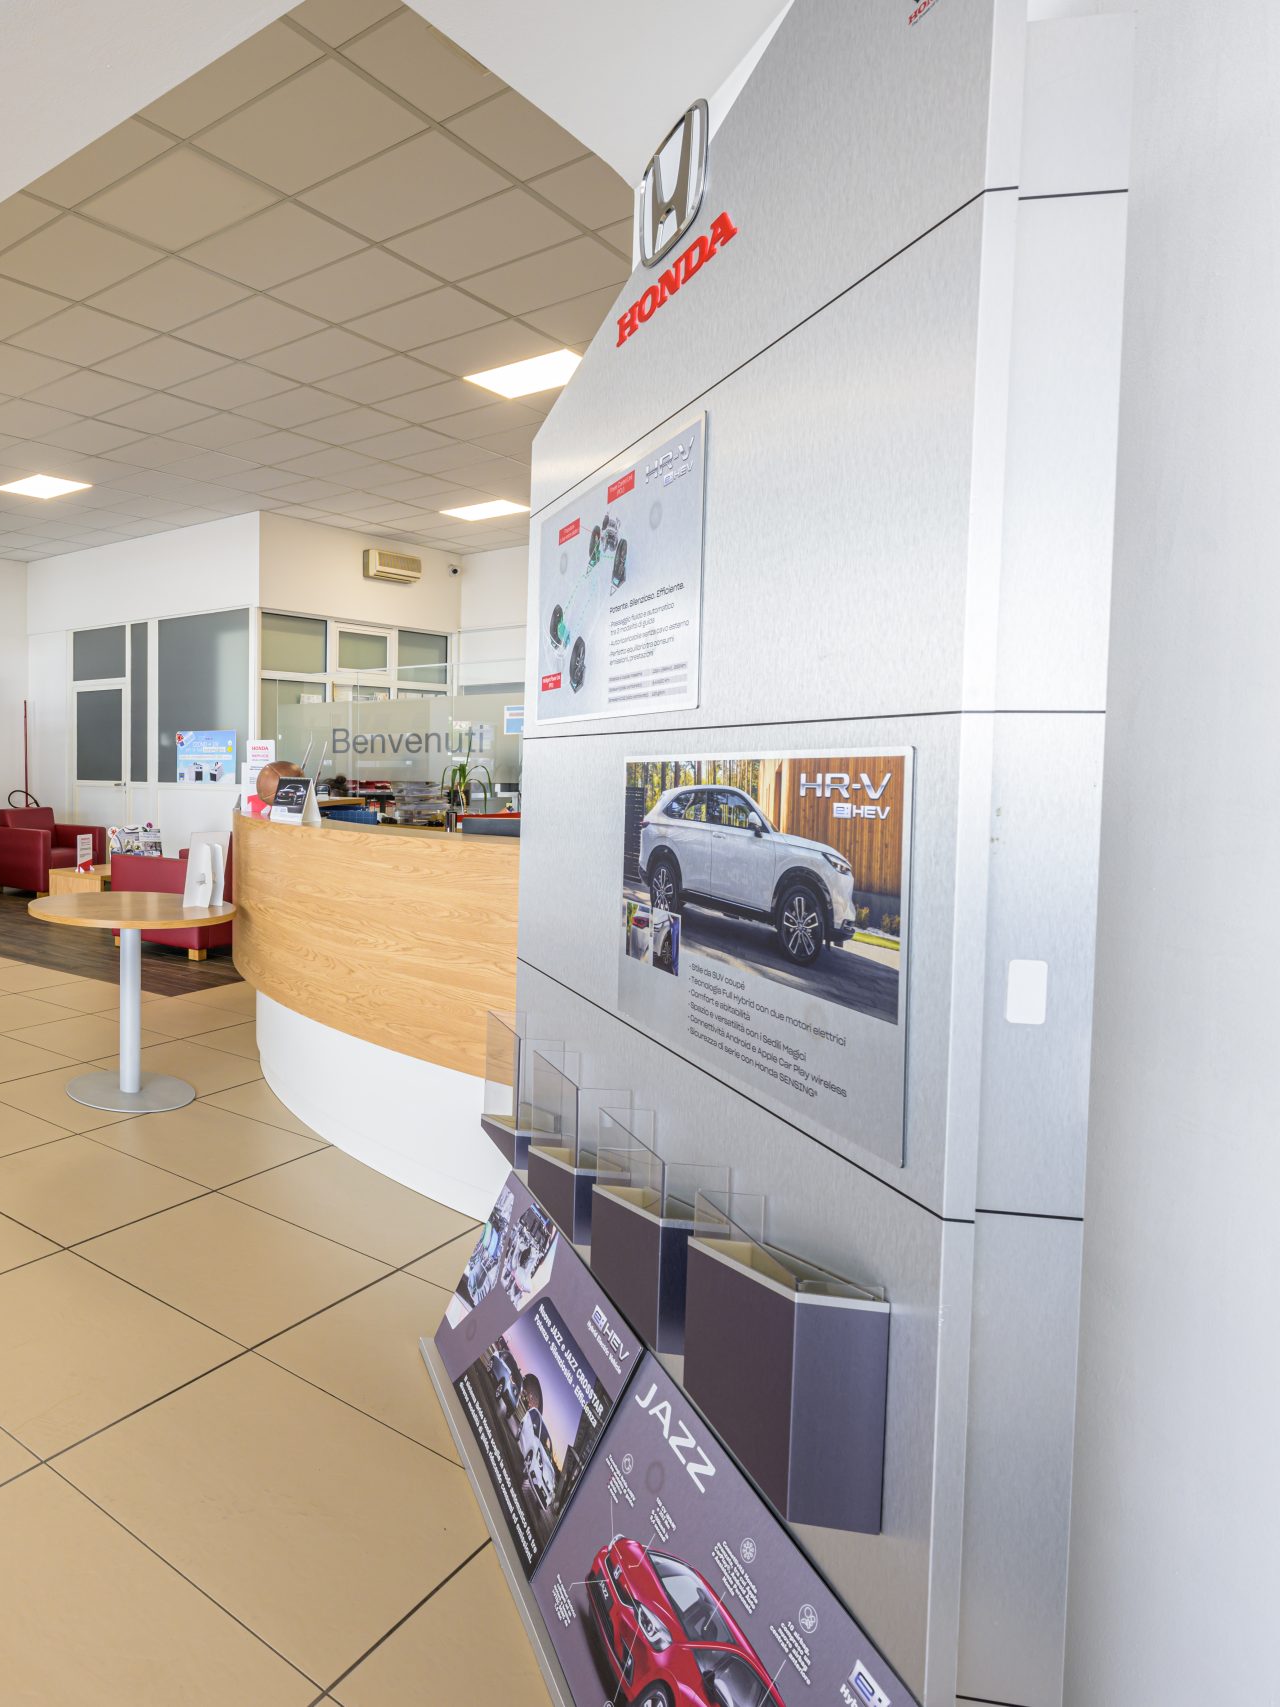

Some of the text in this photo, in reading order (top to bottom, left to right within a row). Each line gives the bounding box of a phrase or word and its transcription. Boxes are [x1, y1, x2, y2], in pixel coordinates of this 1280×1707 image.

[616, 211, 738, 348] HONDA
[645, 435, 695, 484] HR-V
[656, 582, 685, 598] Efficiente.
[332, 725, 484, 754] Benvenuti
[800, 773, 891, 799] HR-V
[690, 988, 714, 1005] Comfort
[720, 1001, 751, 1021] abitabilità
[703, 968, 711, 977] da
[712, 971, 724, 982] SUV
[724, 977, 746, 990] coupé
[690, 1001, 709, 1016] Spazio
[714, 1013, 745, 1032] versatilità
[745, 1028, 759, 1040] con
[762, 1034, 781, 1050] Sedili
[782, 1043, 807, 1062] Magici
[691, 976, 847, 1046] Tecnologia Full Hybrid con due motori elettrici
[689, 1026, 718, 1047] Sicurezza
[724, 1045, 740, 1059] serie
[740, 1054, 755, 1067] con
[754, 1062, 778, 1079] Honda
[690, 1014, 725, 1037] Connettività
[725, 1031, 751, 1050] Android
[757, 1047, 778, 1064] Apple
[779, 1057, 792, 1070] Car
[793, 1064, 810, 1080] Play
[810, 1074, 847, 1097] wireless
[534, 1314, 549, 1342] Potenza
[550, 1342, 573, 1385] Silenziosità
[574, 1385, 597, 1428] Efficienza
[538, 1303, 552, 1327] Nuove
[550, 1325, 563, 1346] JAZZ
[564, 1349, 578, 1372] JAZZ
[576, 1368, 603, 1416] CROSSTAR
[635, 1383, 716, 1494] JAZZ
[500, 1483, 514, 1514] consumi
[516, 1523, 533, 1564] emissioni.
[510, 1487, 527, 1528] automatico
[788, 1621, 794, 1631] 10
